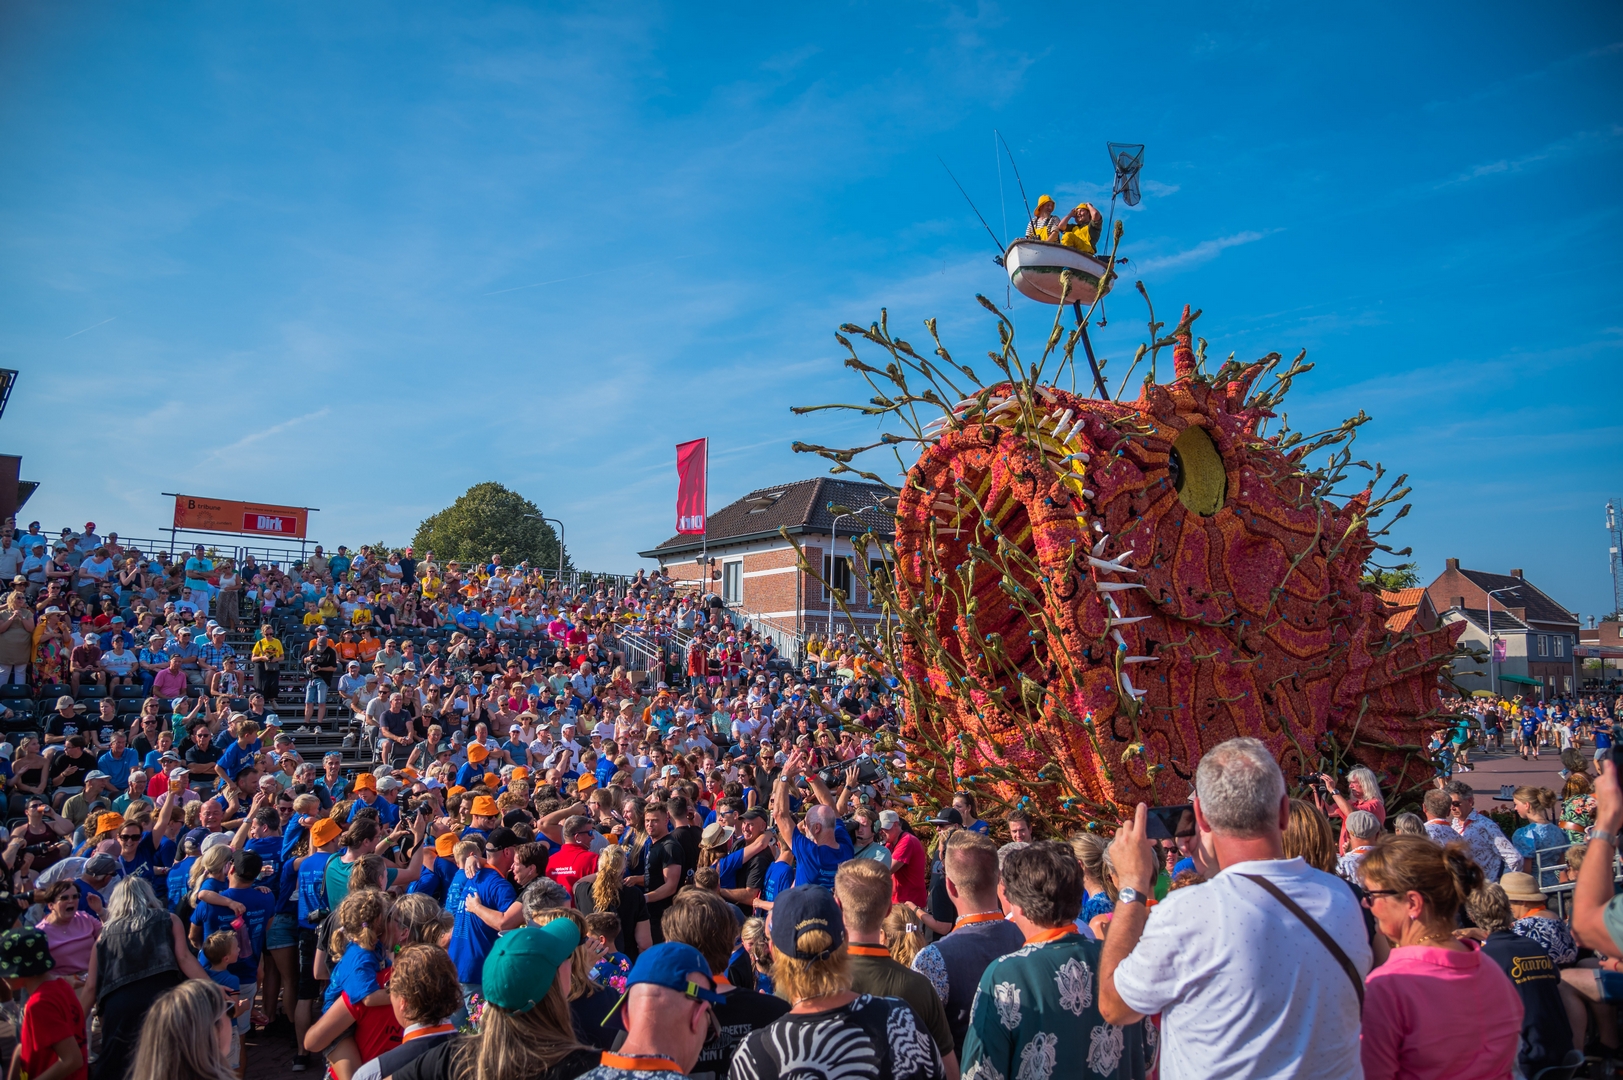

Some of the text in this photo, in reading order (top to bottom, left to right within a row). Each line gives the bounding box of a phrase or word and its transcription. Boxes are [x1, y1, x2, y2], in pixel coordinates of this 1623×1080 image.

[188, 500, 196, 509] B
[257, 515, 283, 531] Dirk
[794, 917, 829, 931] Netherlands
